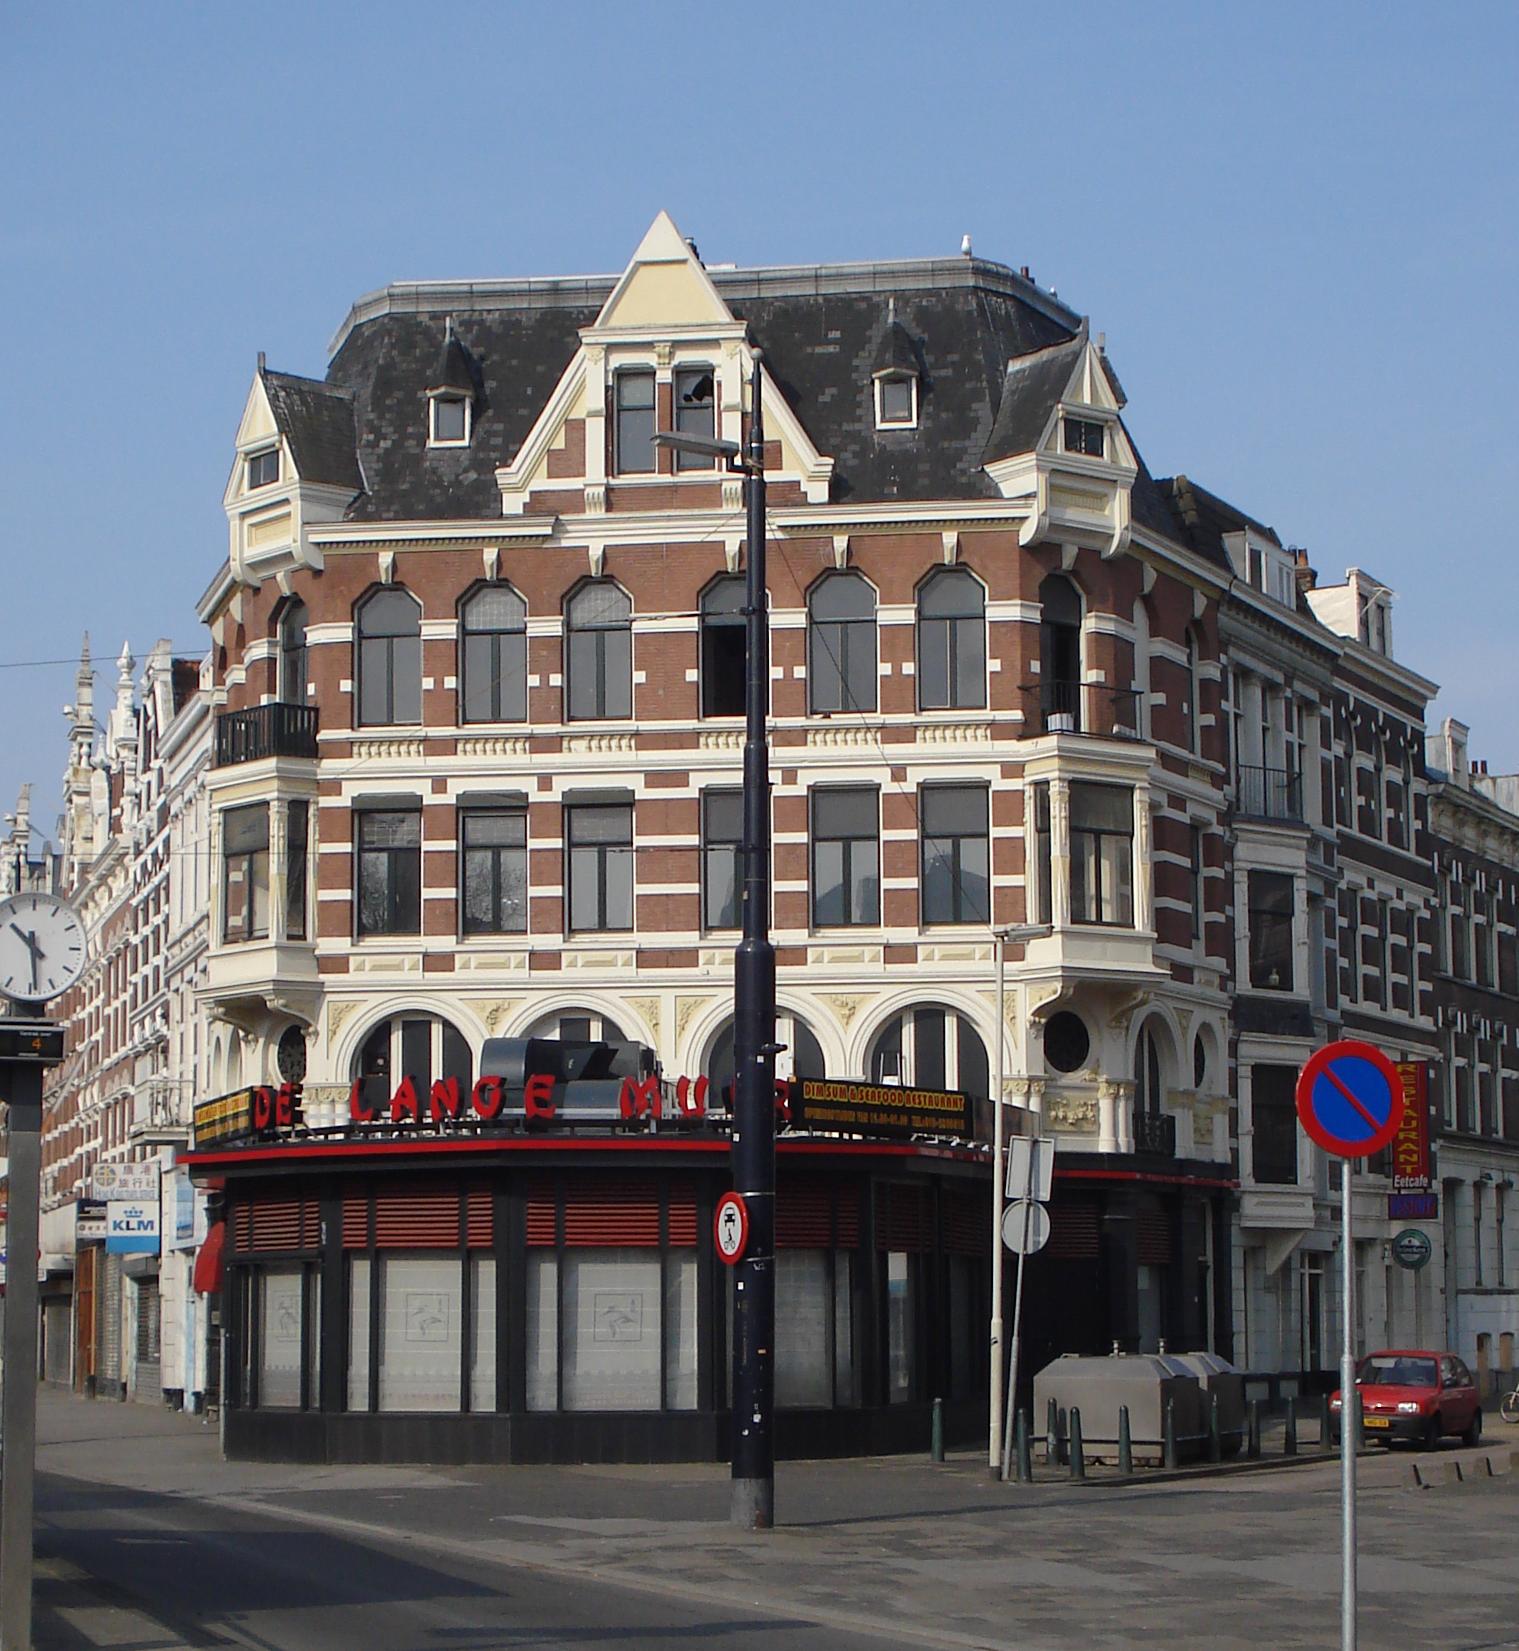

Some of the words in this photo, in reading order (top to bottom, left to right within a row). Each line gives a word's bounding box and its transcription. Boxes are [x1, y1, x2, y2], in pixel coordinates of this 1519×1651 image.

[254, 1082, 294, 1129] DE
[350, 1074, 557, 1124] LANGE
[620, 1074, 793, 1121] MUR
[803, 1081, 825, 1099] DIM
[825, 1084, 848, 1102] SUM
[849, 1086, 857, 1103] &
[857, 1087, 904, 1106] SEAFOOD
[905, 1091, 964, 1111] RESTAURANT
[1396, 1064, 1418, 1174] RESTAURANT
[112, 1220, 154, 1231] KLM
